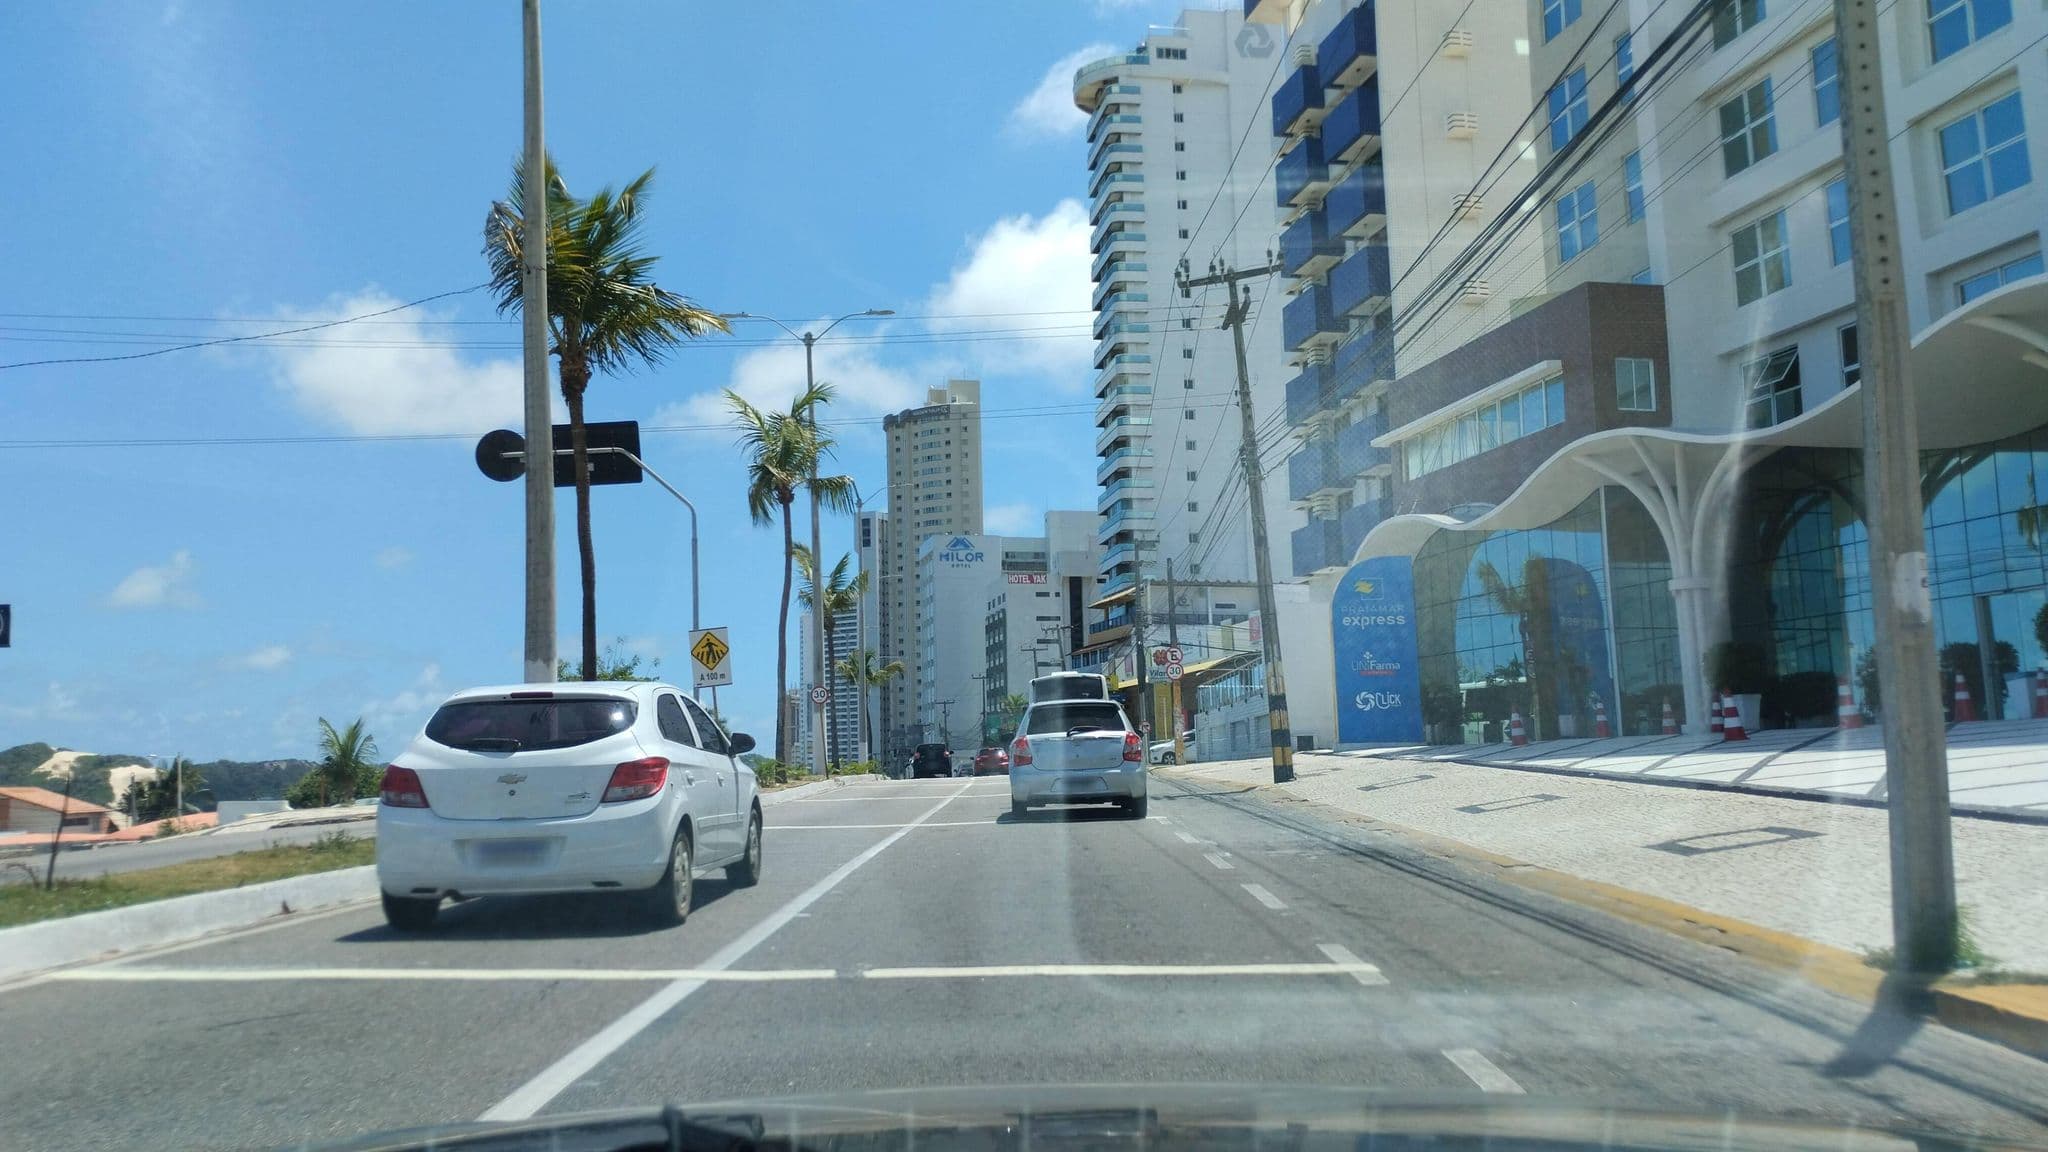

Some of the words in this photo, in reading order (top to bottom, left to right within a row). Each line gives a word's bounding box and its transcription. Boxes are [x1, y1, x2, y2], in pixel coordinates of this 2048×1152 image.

[939, 552, 984, 562] MILOR
[1008, 574, 1031, 583] HOTEL
[1032, 574, 1047, 584] YAK
[1343, 615, 1406, 630] express
[1170, 666, 1180, 675] 30
[699, 673, 706, 682] A
[706, 672, 718, 680] 100
[814, 690, 826, 698] 30
